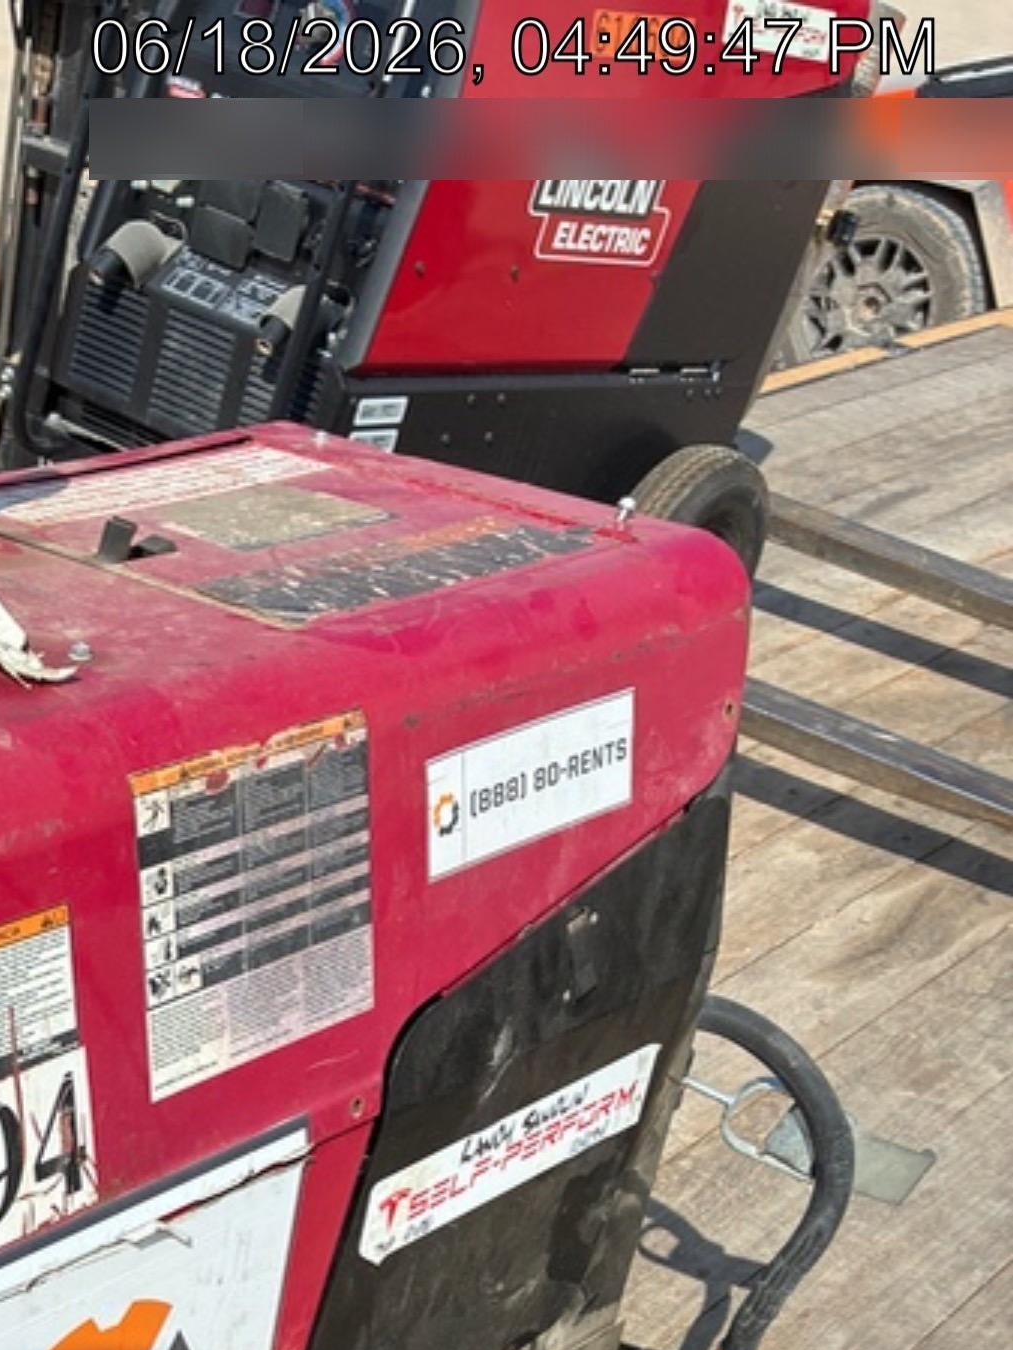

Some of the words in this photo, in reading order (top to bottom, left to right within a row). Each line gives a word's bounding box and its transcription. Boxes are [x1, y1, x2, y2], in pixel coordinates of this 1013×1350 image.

[537, 180, 658, 215] LINCOLN
[551, 220, 652, 256] ELECTRIC
[470, 772, 528, 817] (888)
